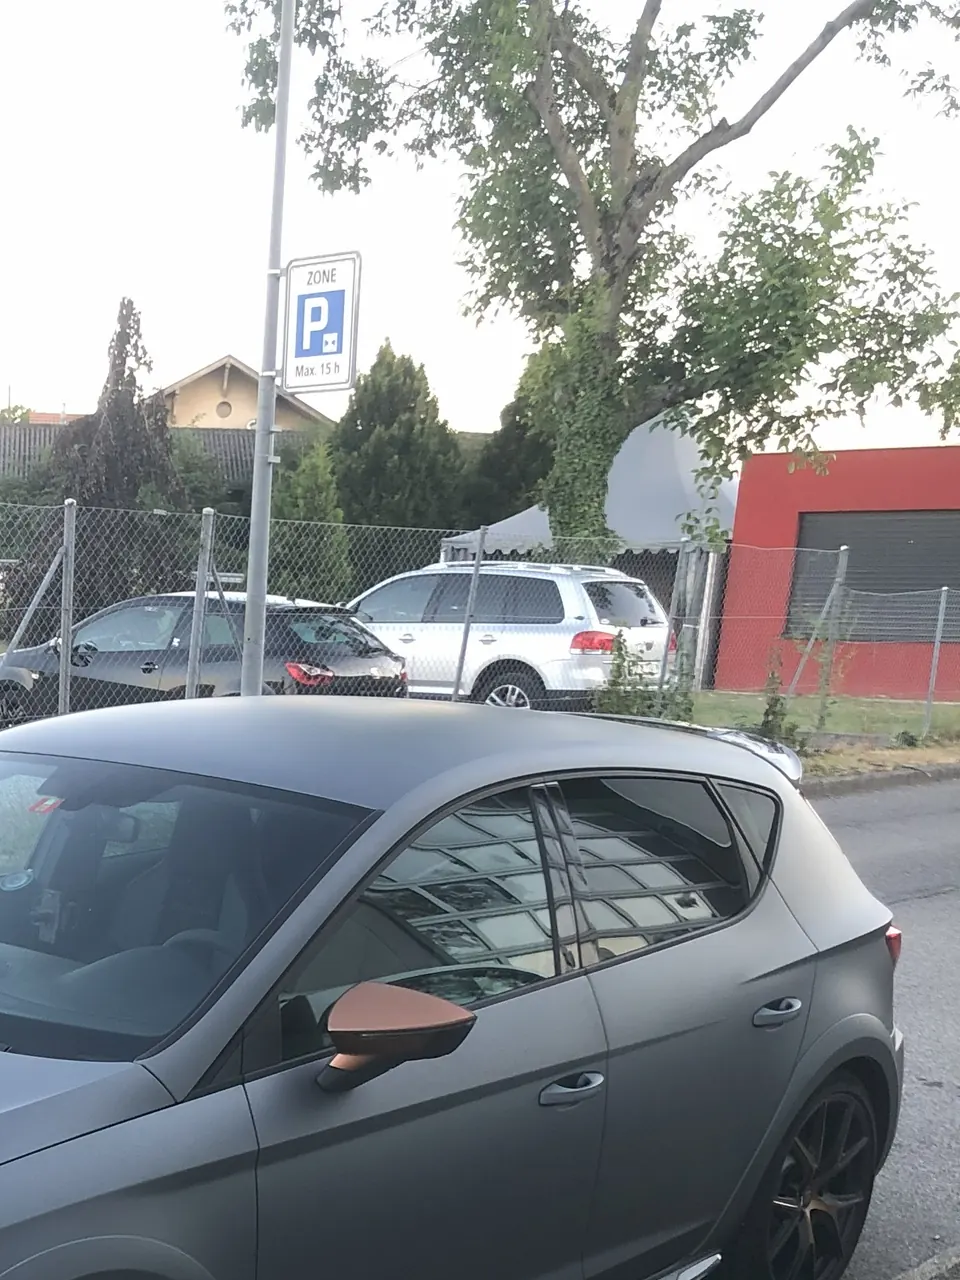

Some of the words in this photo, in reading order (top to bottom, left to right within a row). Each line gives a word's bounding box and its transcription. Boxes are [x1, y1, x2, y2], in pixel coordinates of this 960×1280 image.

[307, 268, 337, 286] ZONE
[302, 296, 329, 351] P
[295, 364, 317, 378] Max.
[320, 363, 331, 375] 15
[334, 363, 340, 374] h
